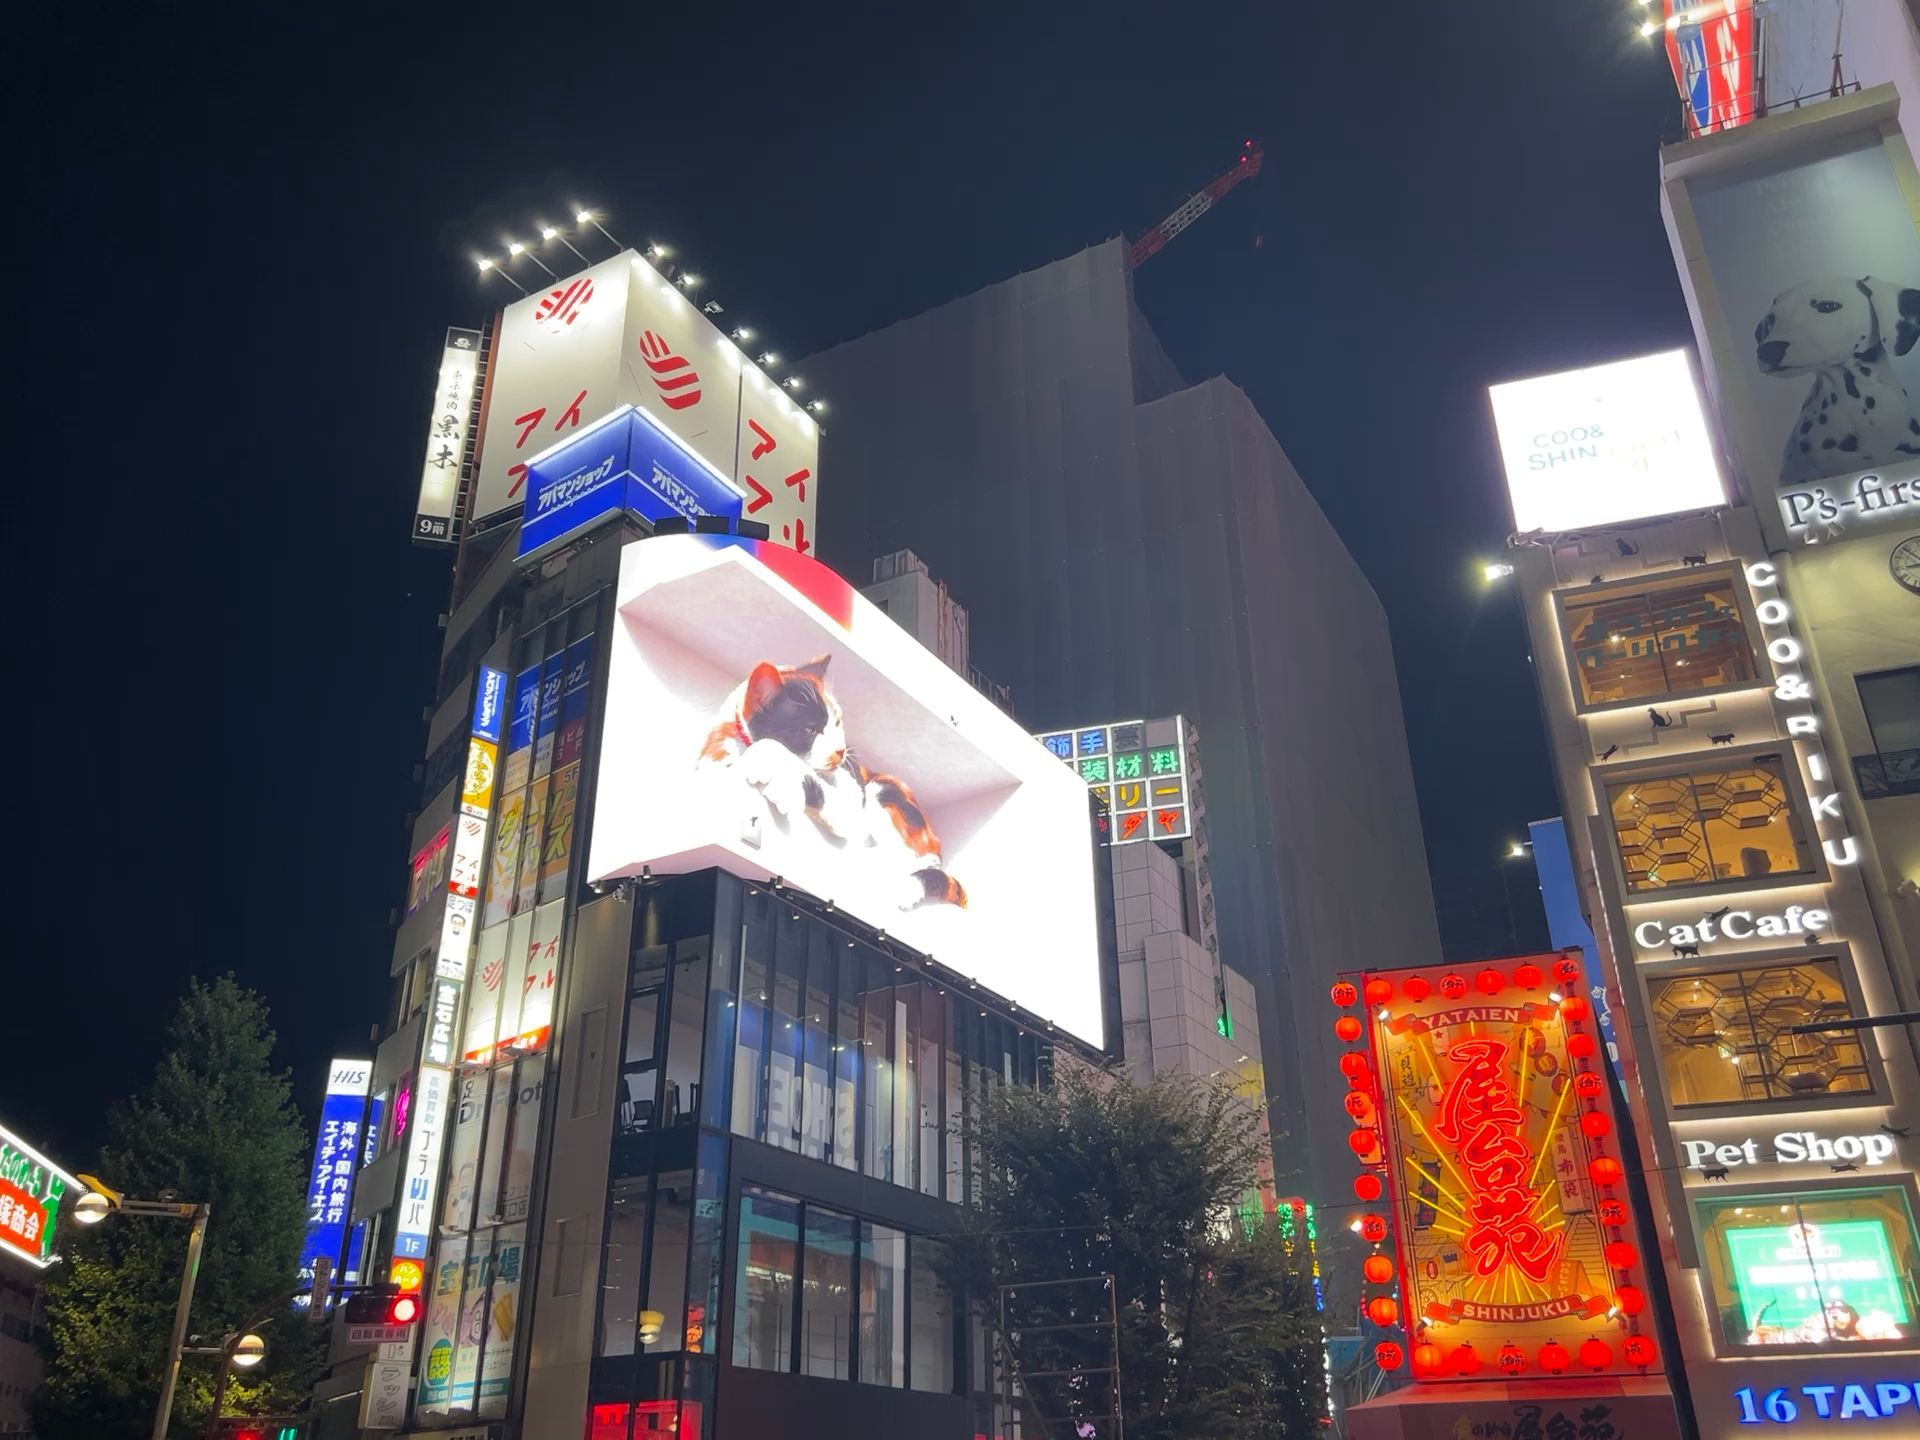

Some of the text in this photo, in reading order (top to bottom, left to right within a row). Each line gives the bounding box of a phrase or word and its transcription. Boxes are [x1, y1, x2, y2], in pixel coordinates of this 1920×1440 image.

[1634, 905, 1830, 949] Cat Cafe
[1422, 1007, 1520, 1032] YATAIEN
[333, 1070, 366, 1085] HIS
[1682, 1131, 1895, 1169] Pet Shop
[1462, 1298, 1571, 1322] SHINJUKU
[1733, 1387, 1799, 1425] 16
